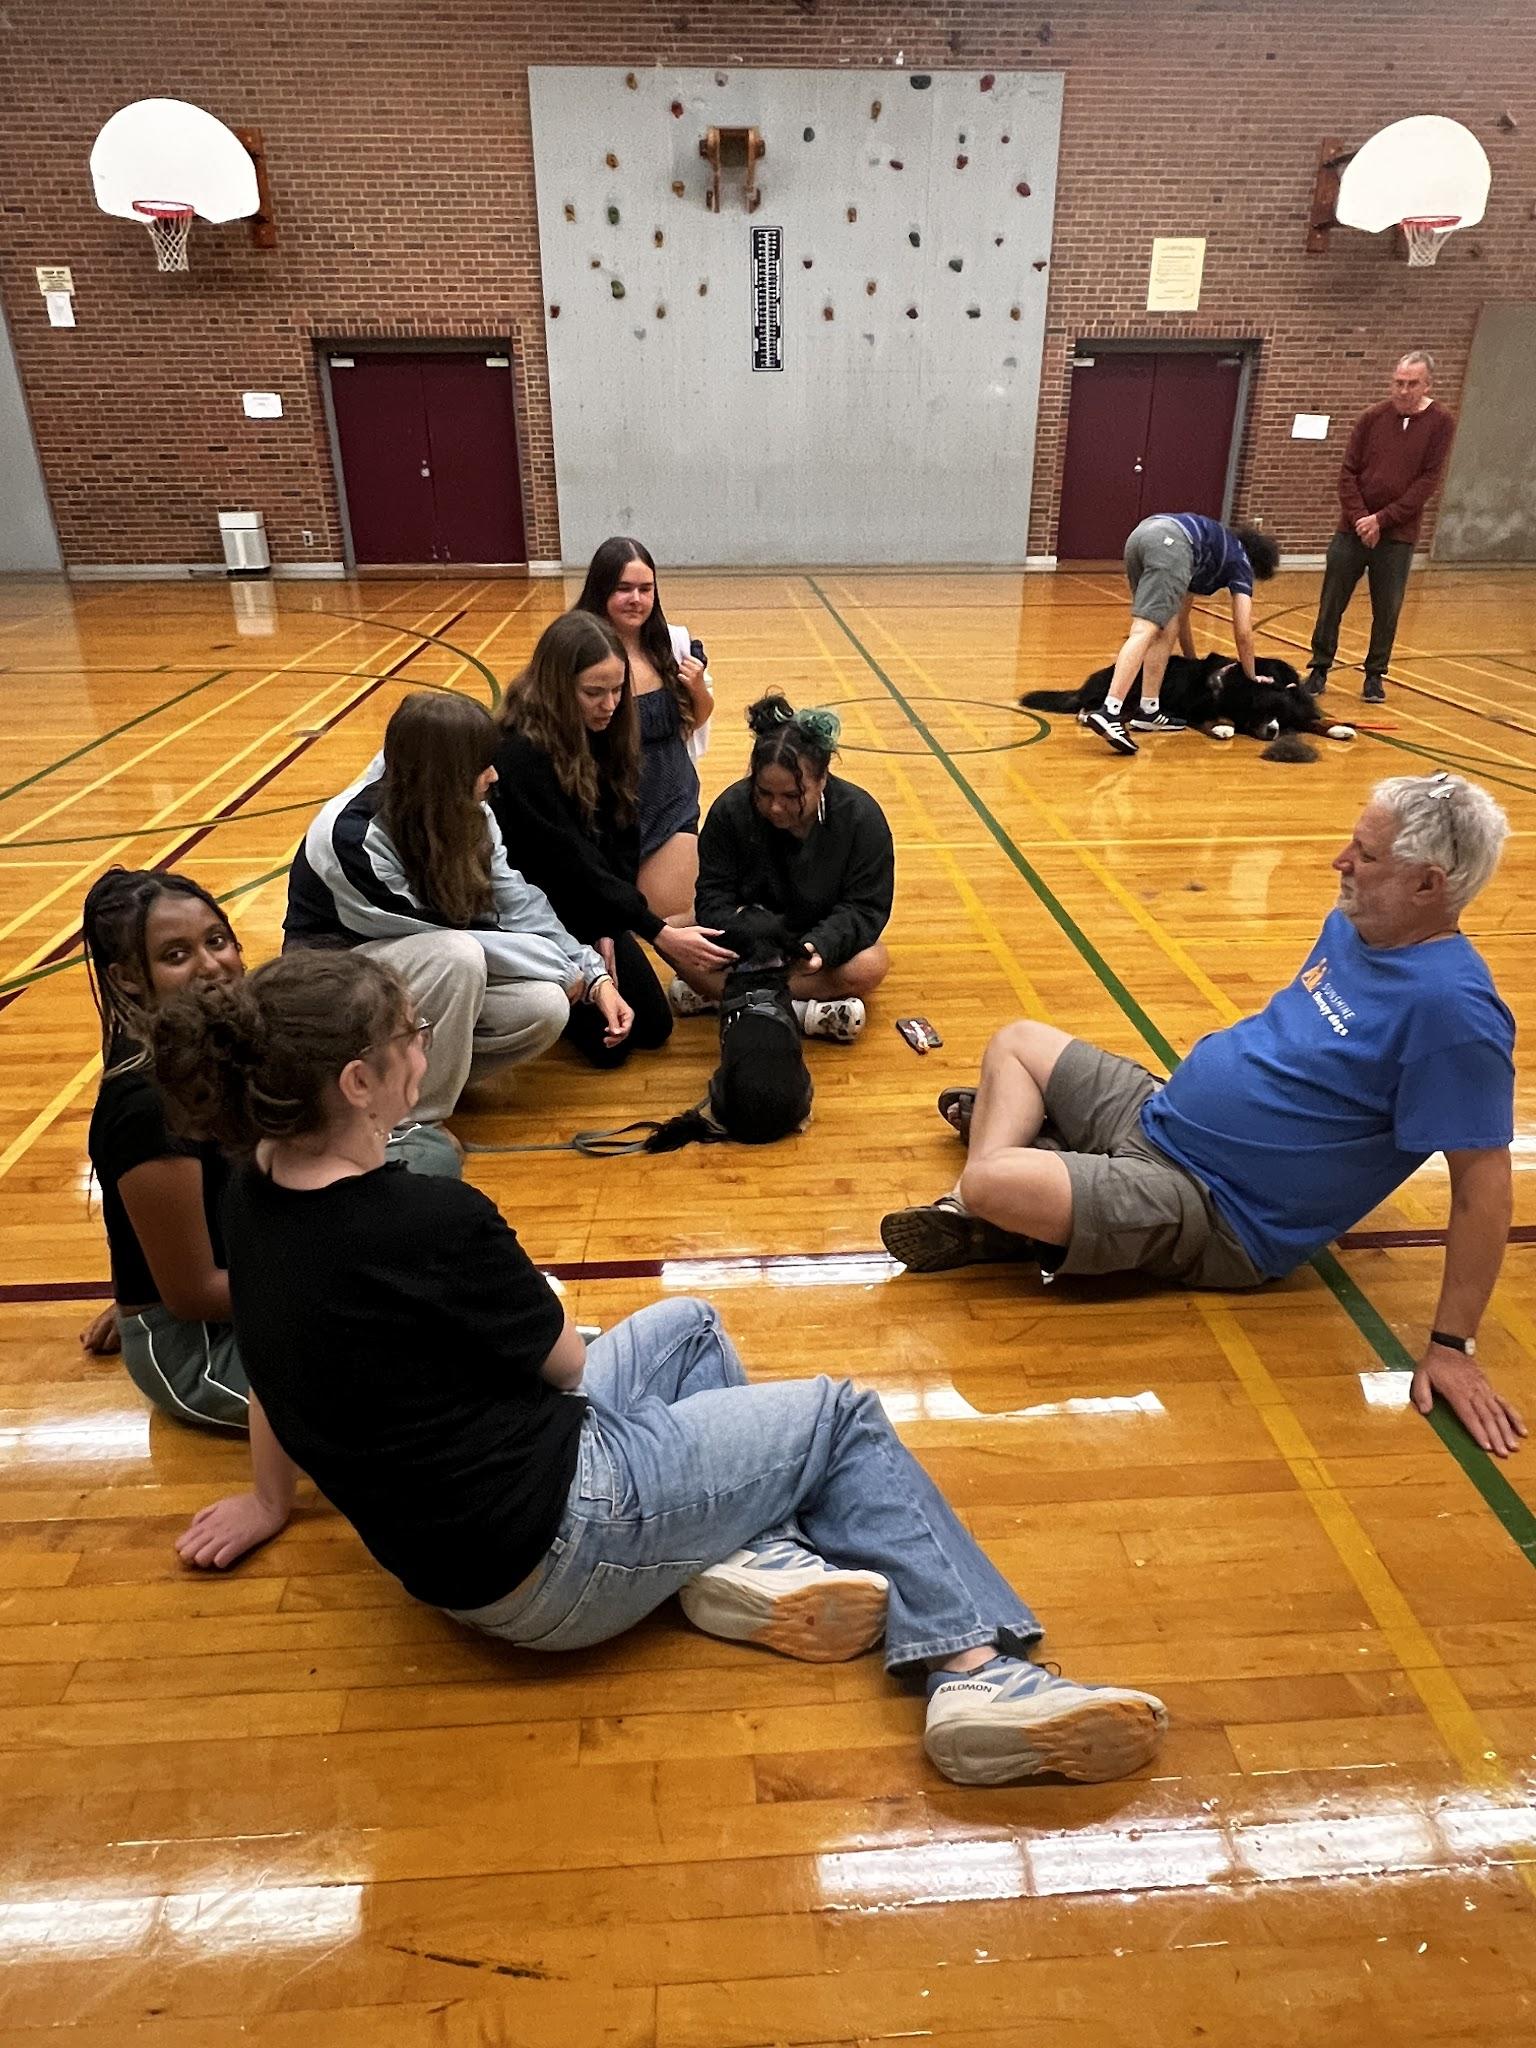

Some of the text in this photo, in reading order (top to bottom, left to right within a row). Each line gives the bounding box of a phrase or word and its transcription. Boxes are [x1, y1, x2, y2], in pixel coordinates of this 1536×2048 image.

[1322, 983, 1355, 1019] SUNSHINE
[1327, 1014, 1349, 1036] dogs
[939, 1683, 992, 1694] SALOMON
